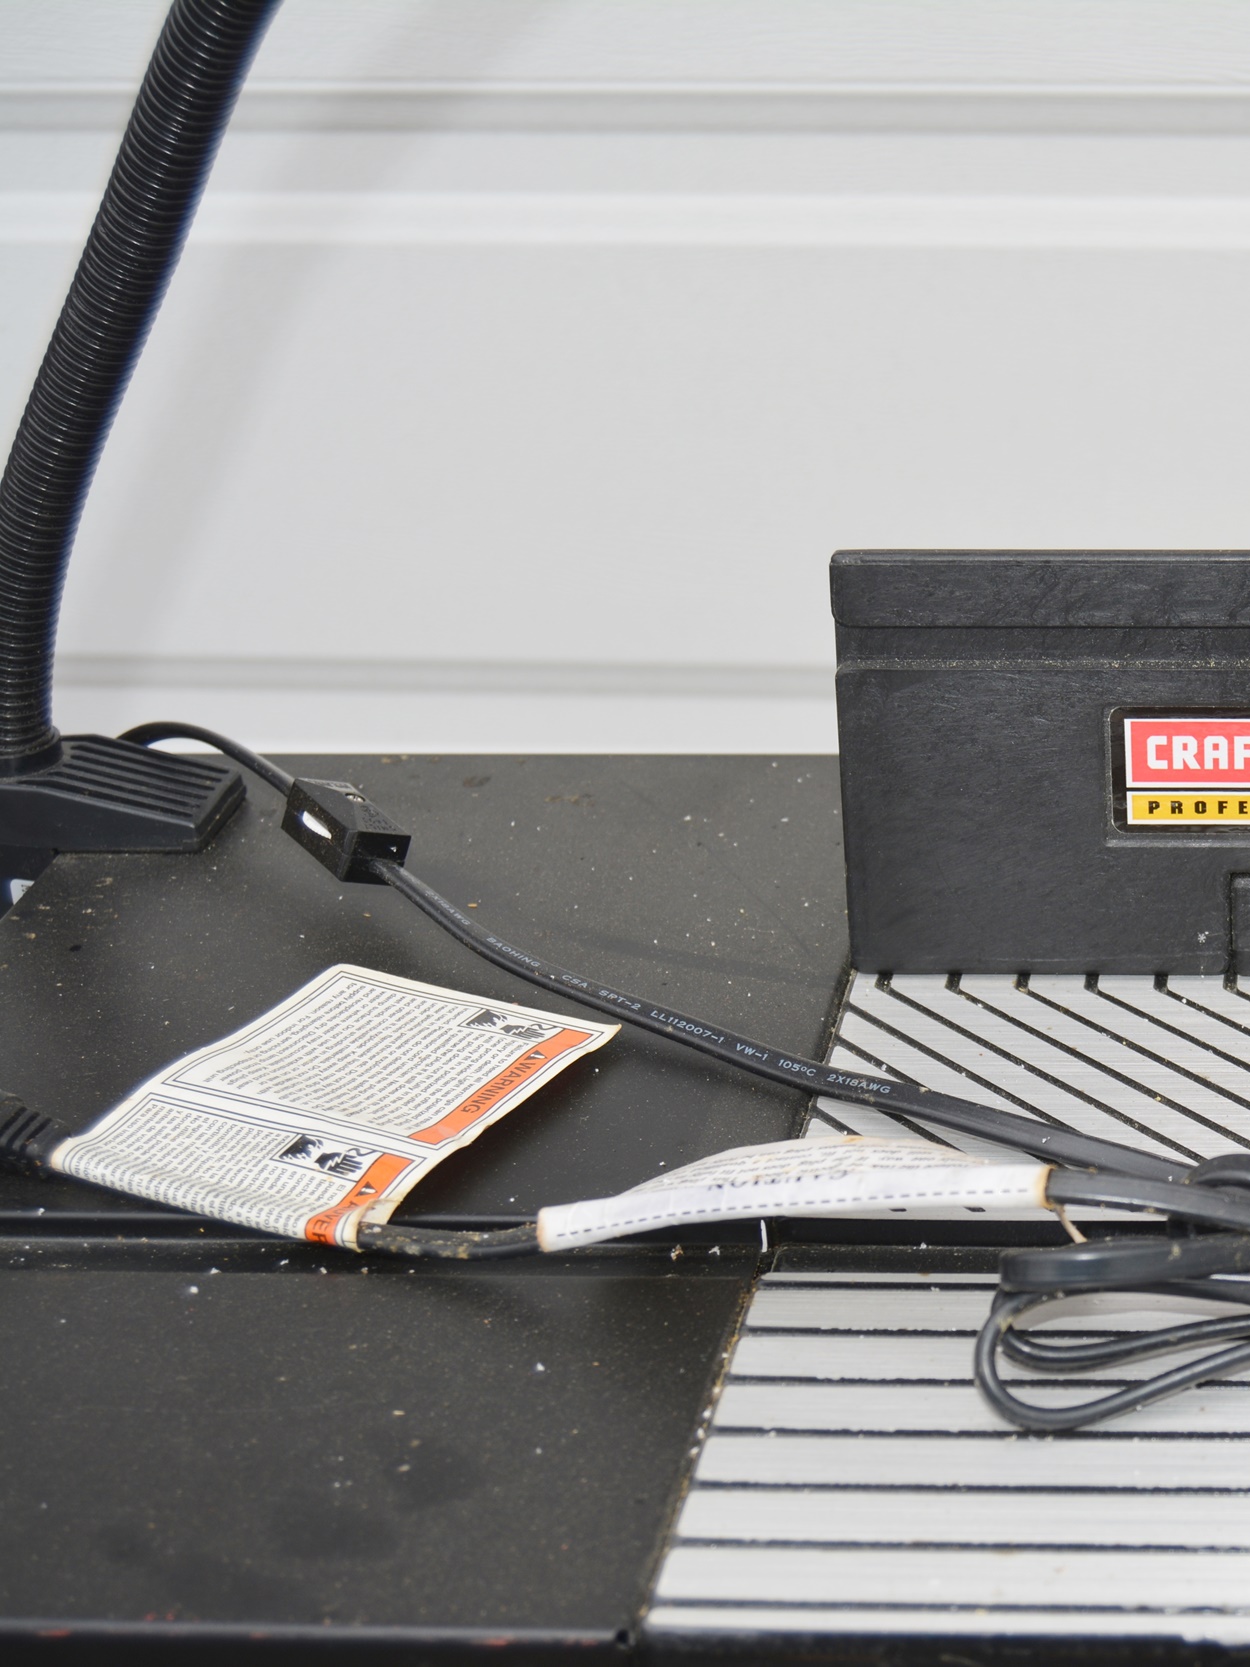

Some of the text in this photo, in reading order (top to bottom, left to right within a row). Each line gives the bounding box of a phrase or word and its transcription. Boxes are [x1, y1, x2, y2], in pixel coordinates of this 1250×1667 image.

[487, 937, 541, 967] BAOHING
[562, 975, 588, 988] CSA
[650, 1010, 725, 1043] LL112007-1
[736, 1043, 768, 1061] VW-1
[826, 1073, 891, 1094] 2X18AWG
[461, 1061, 537, 1114] WARNING
